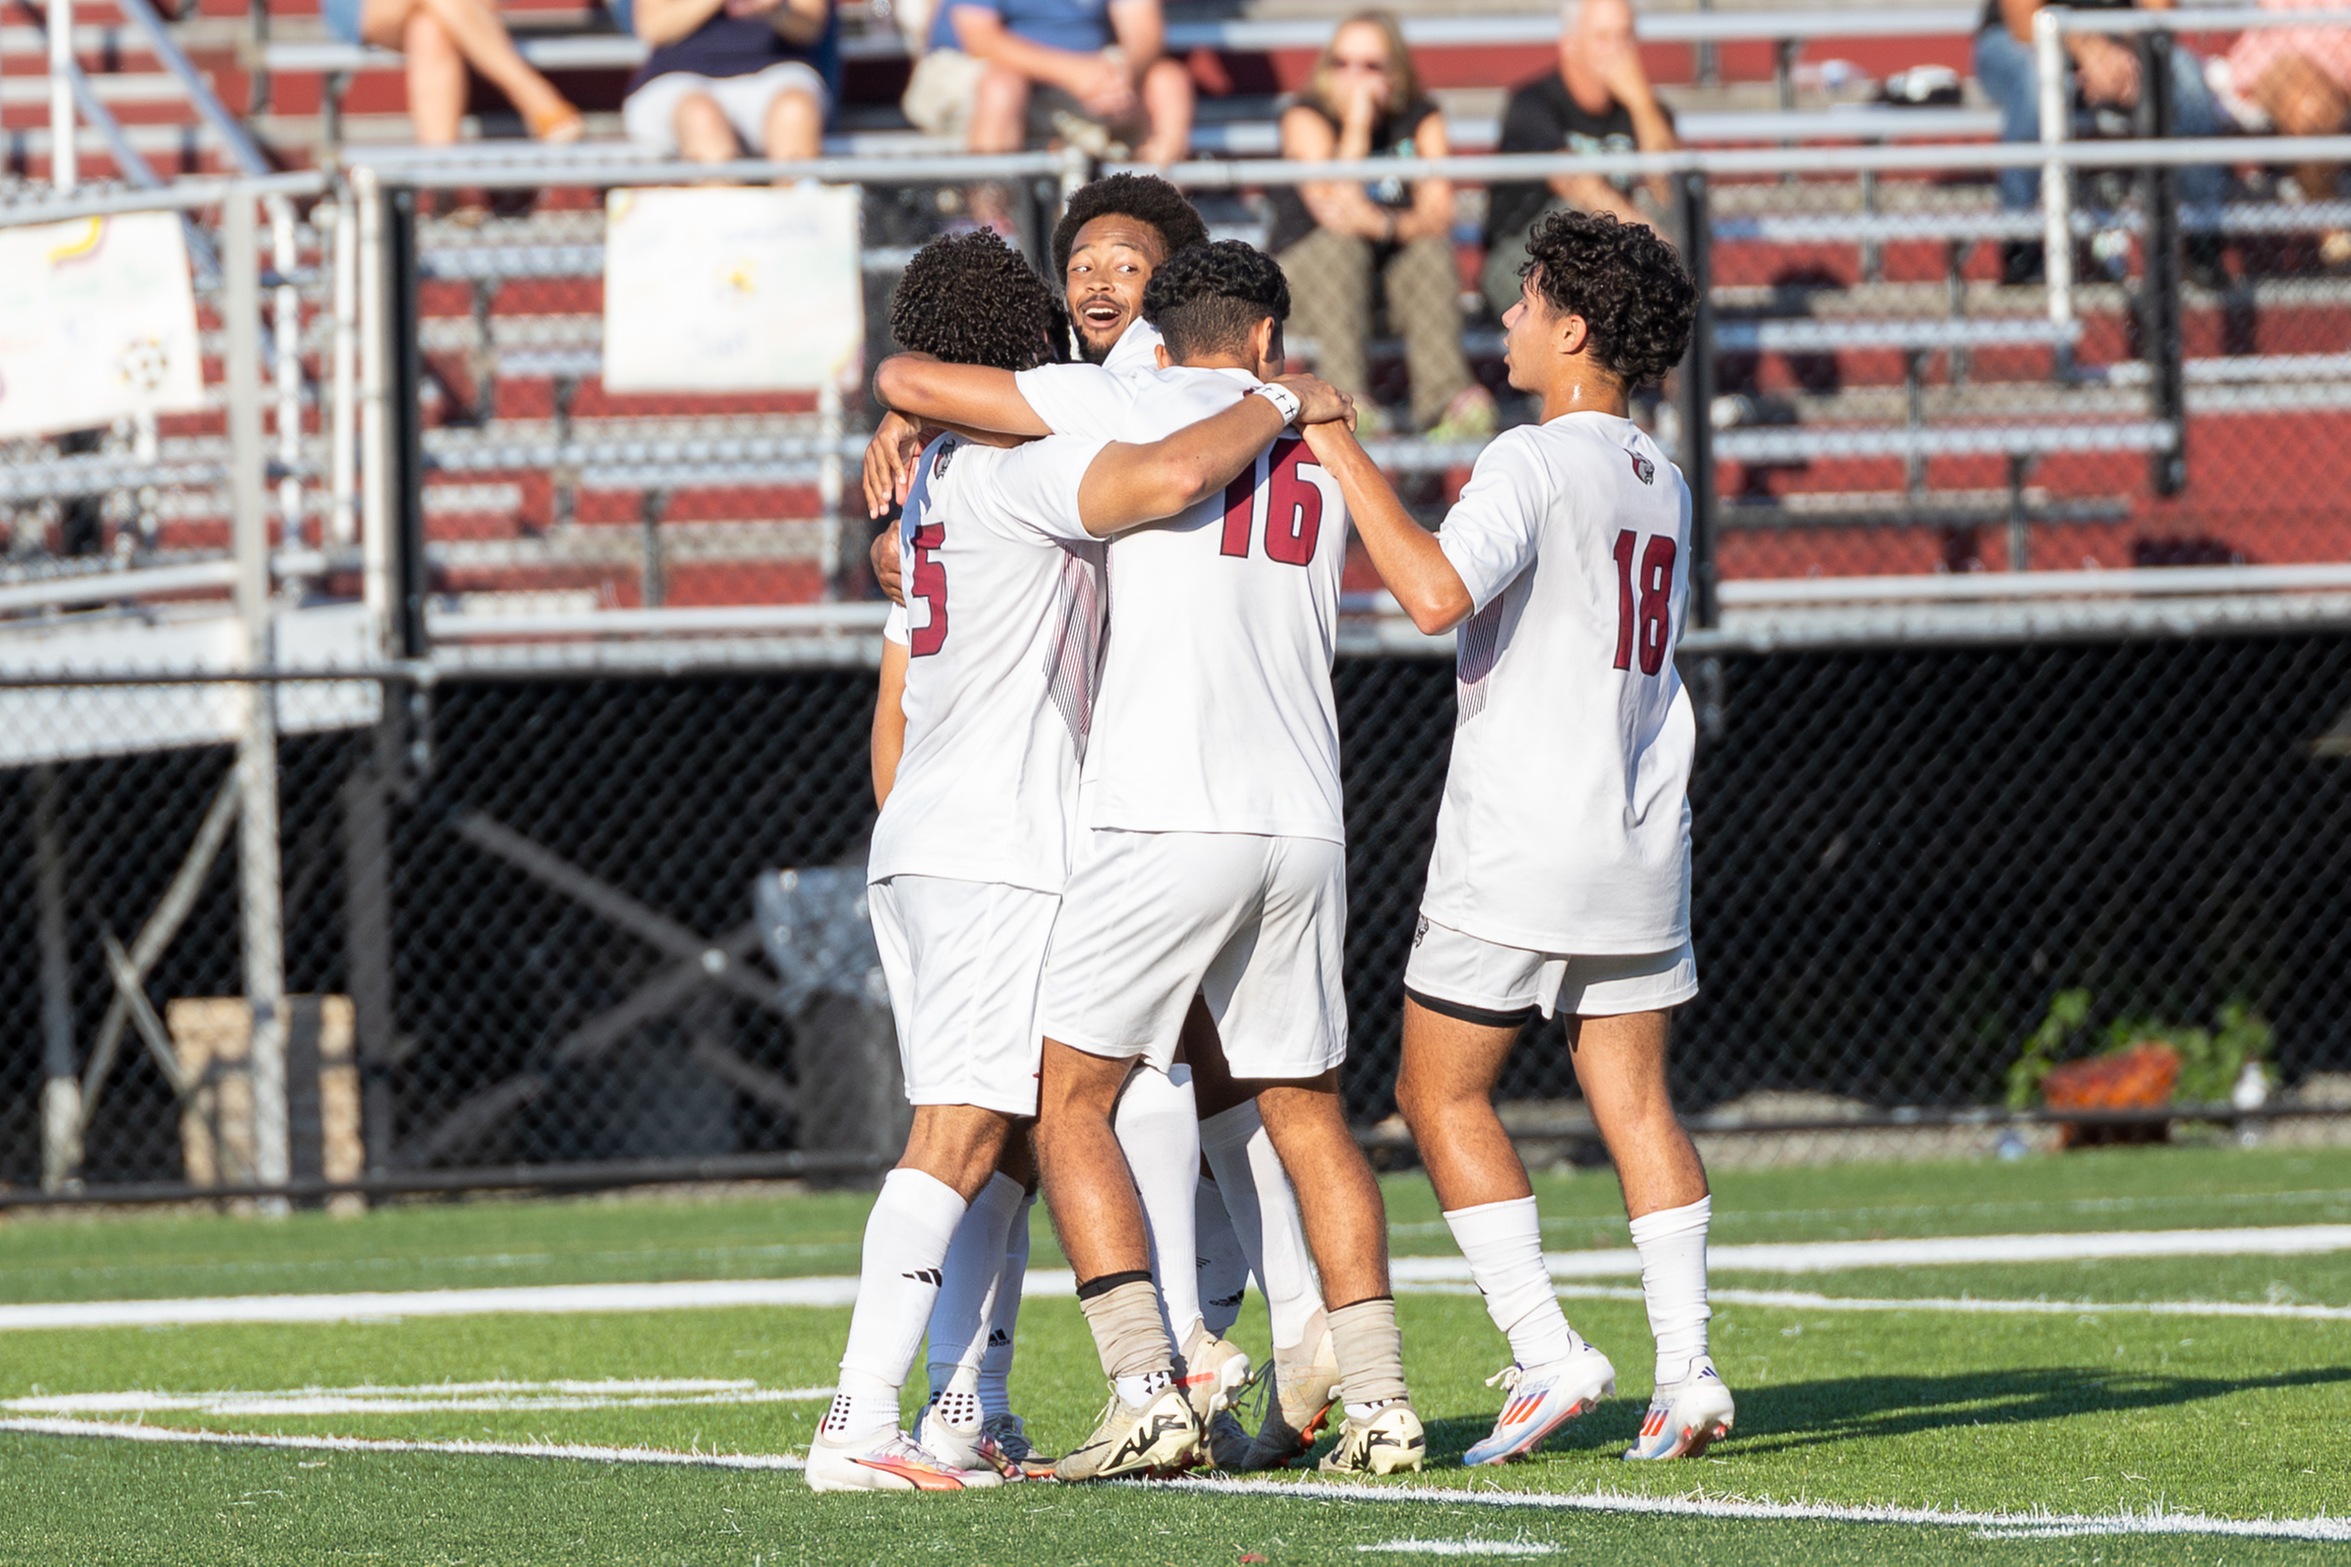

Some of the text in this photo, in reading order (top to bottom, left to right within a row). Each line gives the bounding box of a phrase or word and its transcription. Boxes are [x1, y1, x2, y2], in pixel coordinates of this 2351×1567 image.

[1219, 437, 1323, 567] 16
[911, 521, 949, 658] 5
[1613, 528, 1677, 677] 18
